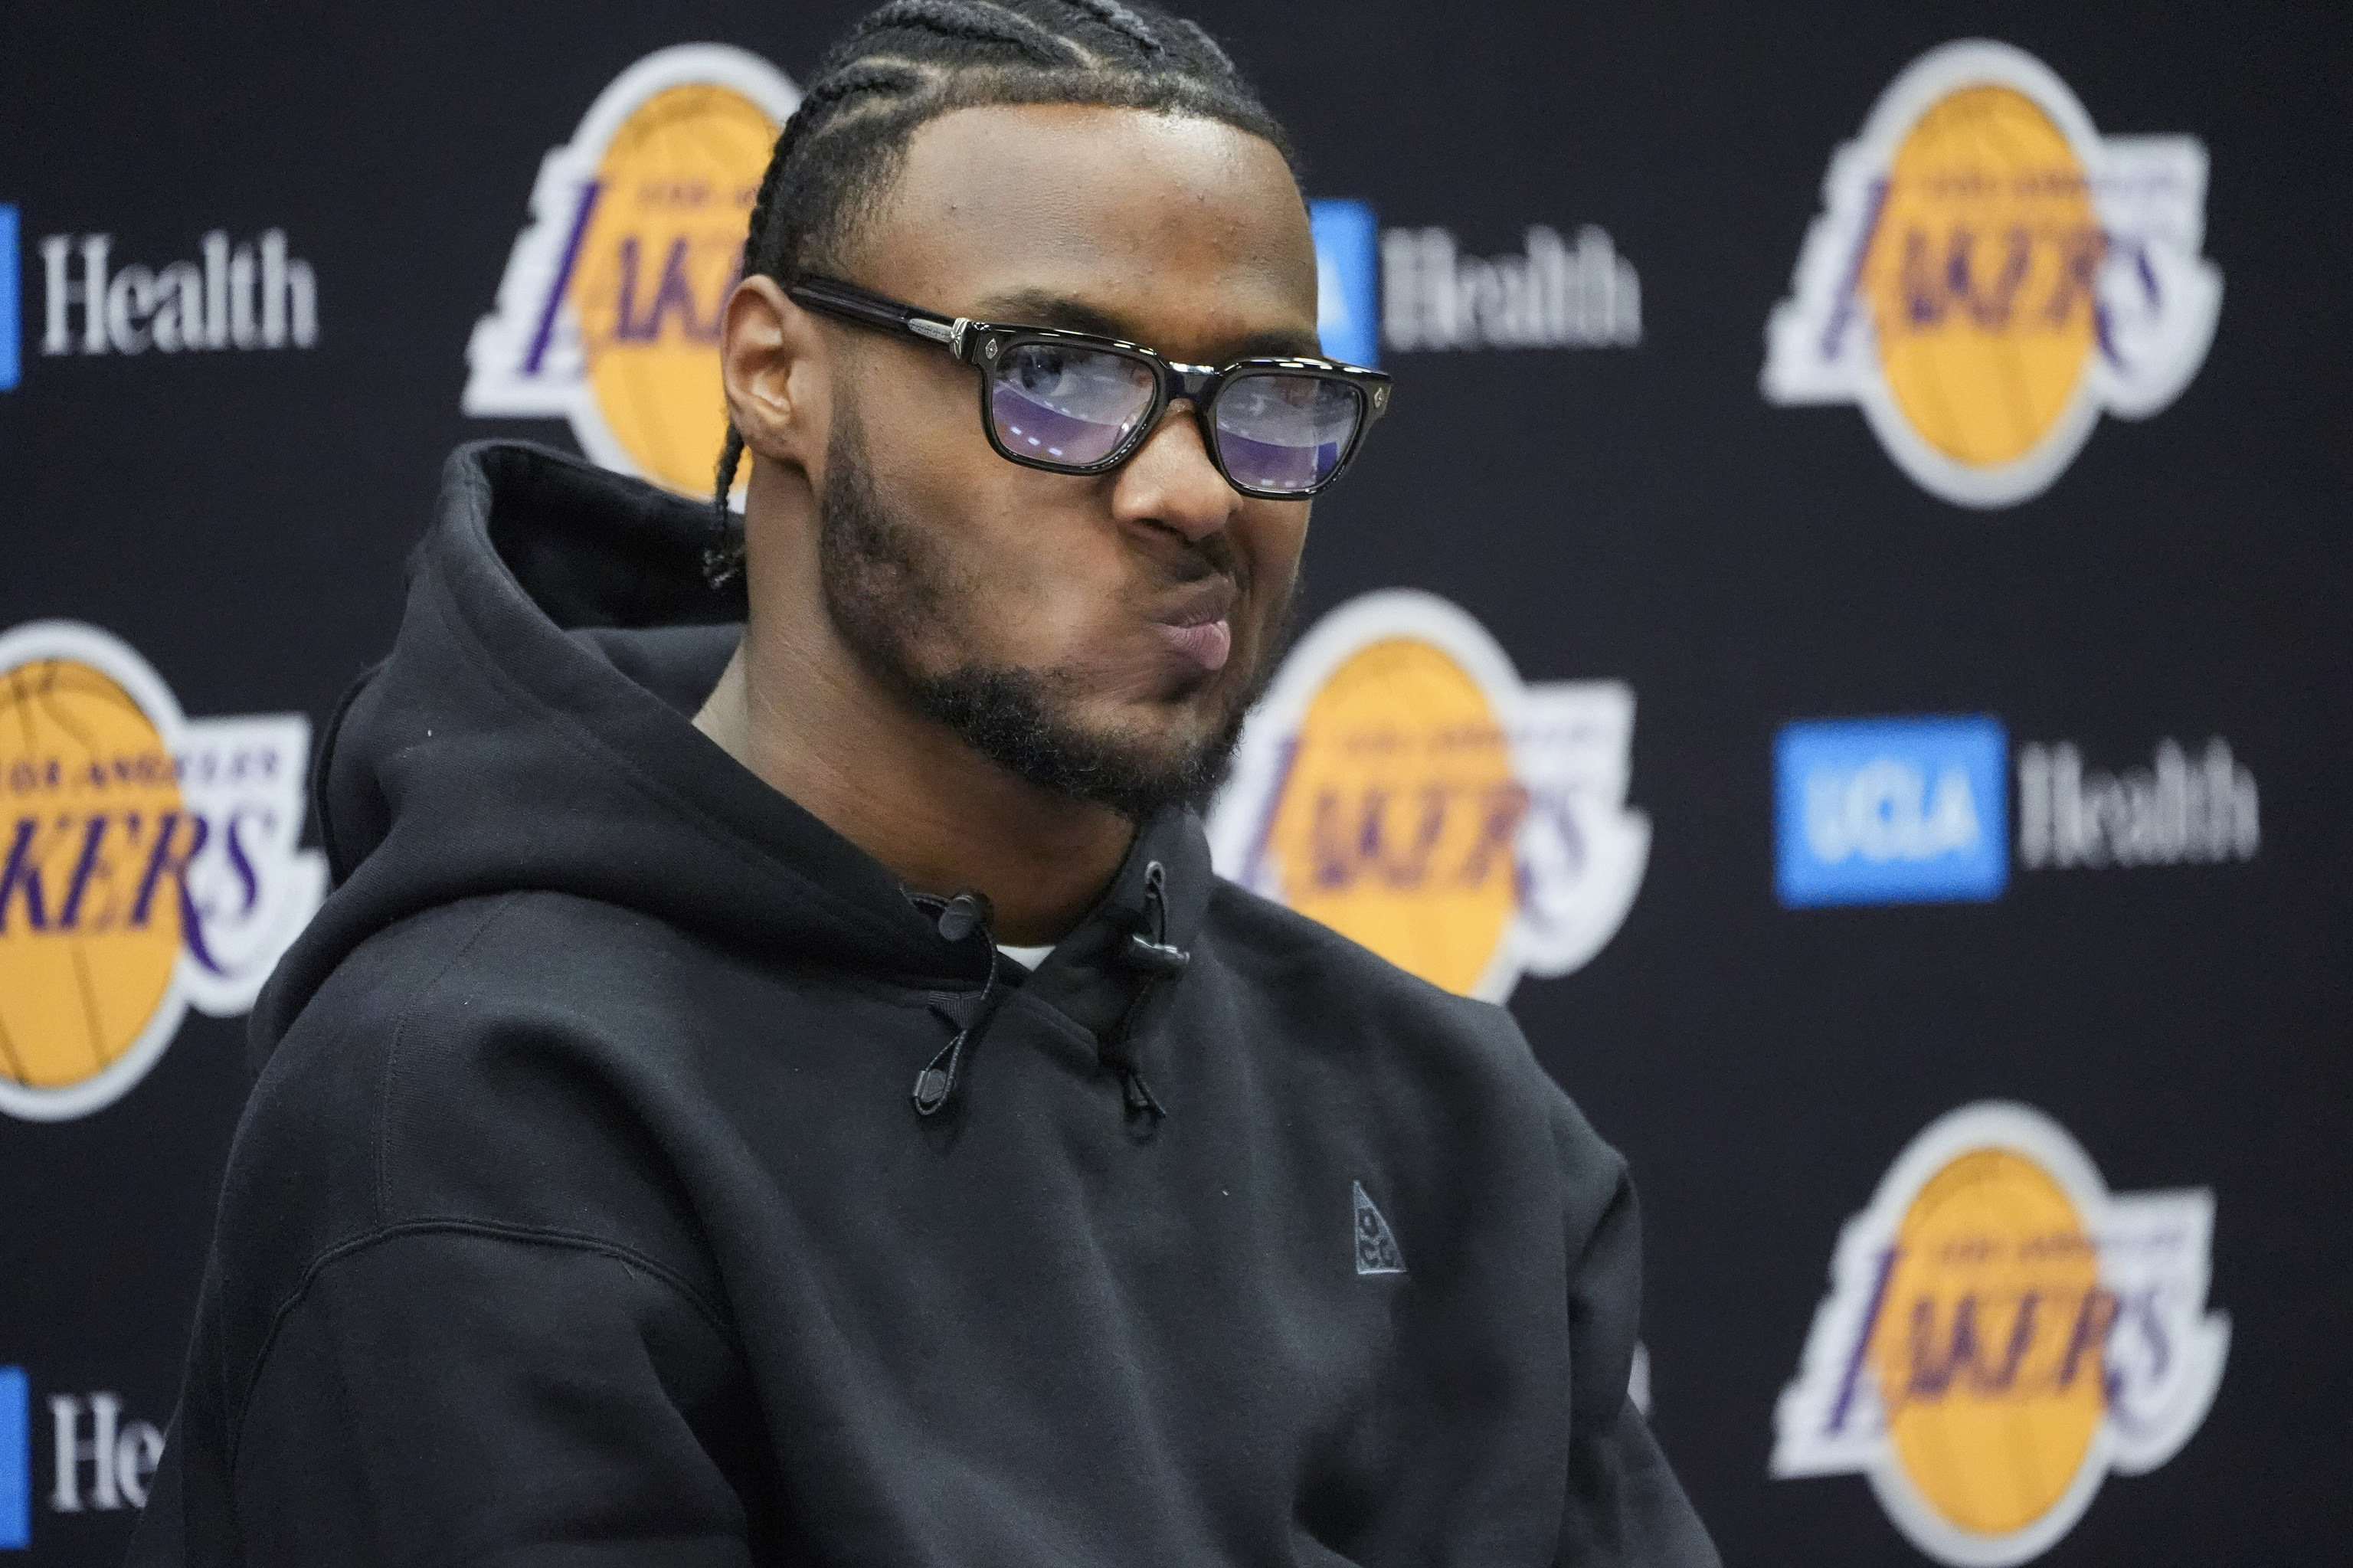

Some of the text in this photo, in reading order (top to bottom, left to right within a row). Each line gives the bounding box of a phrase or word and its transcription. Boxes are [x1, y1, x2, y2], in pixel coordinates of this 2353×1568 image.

[41, 228, 319, 355] Health
[1383, 224, 1642, 352] Health
[1805, 735, 2260, 870] UCLA Health
[49, 1391, 165, 1512] He
